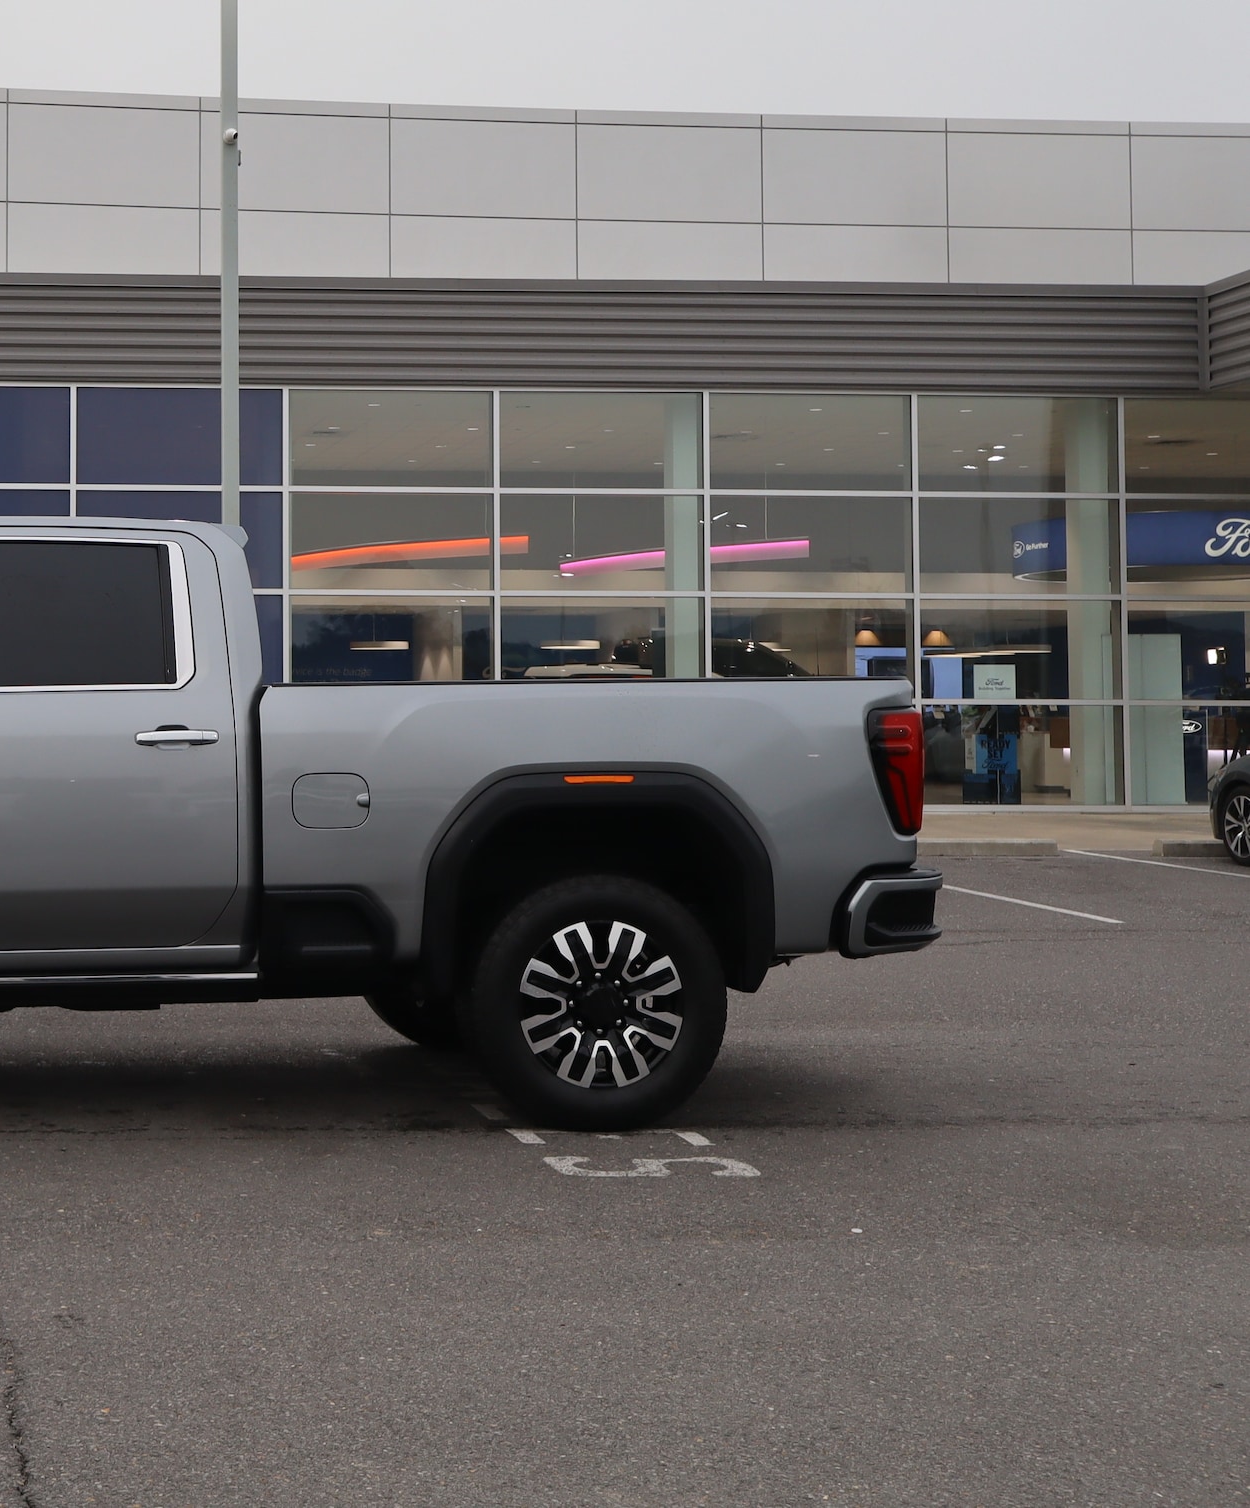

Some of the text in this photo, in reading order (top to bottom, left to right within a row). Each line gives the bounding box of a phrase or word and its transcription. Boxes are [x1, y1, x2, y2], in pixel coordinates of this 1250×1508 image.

[1204, 518, 1250, 557] Fo
[980, 739, 1010, 749] READY
[988, 749, 1003, 759] SET
